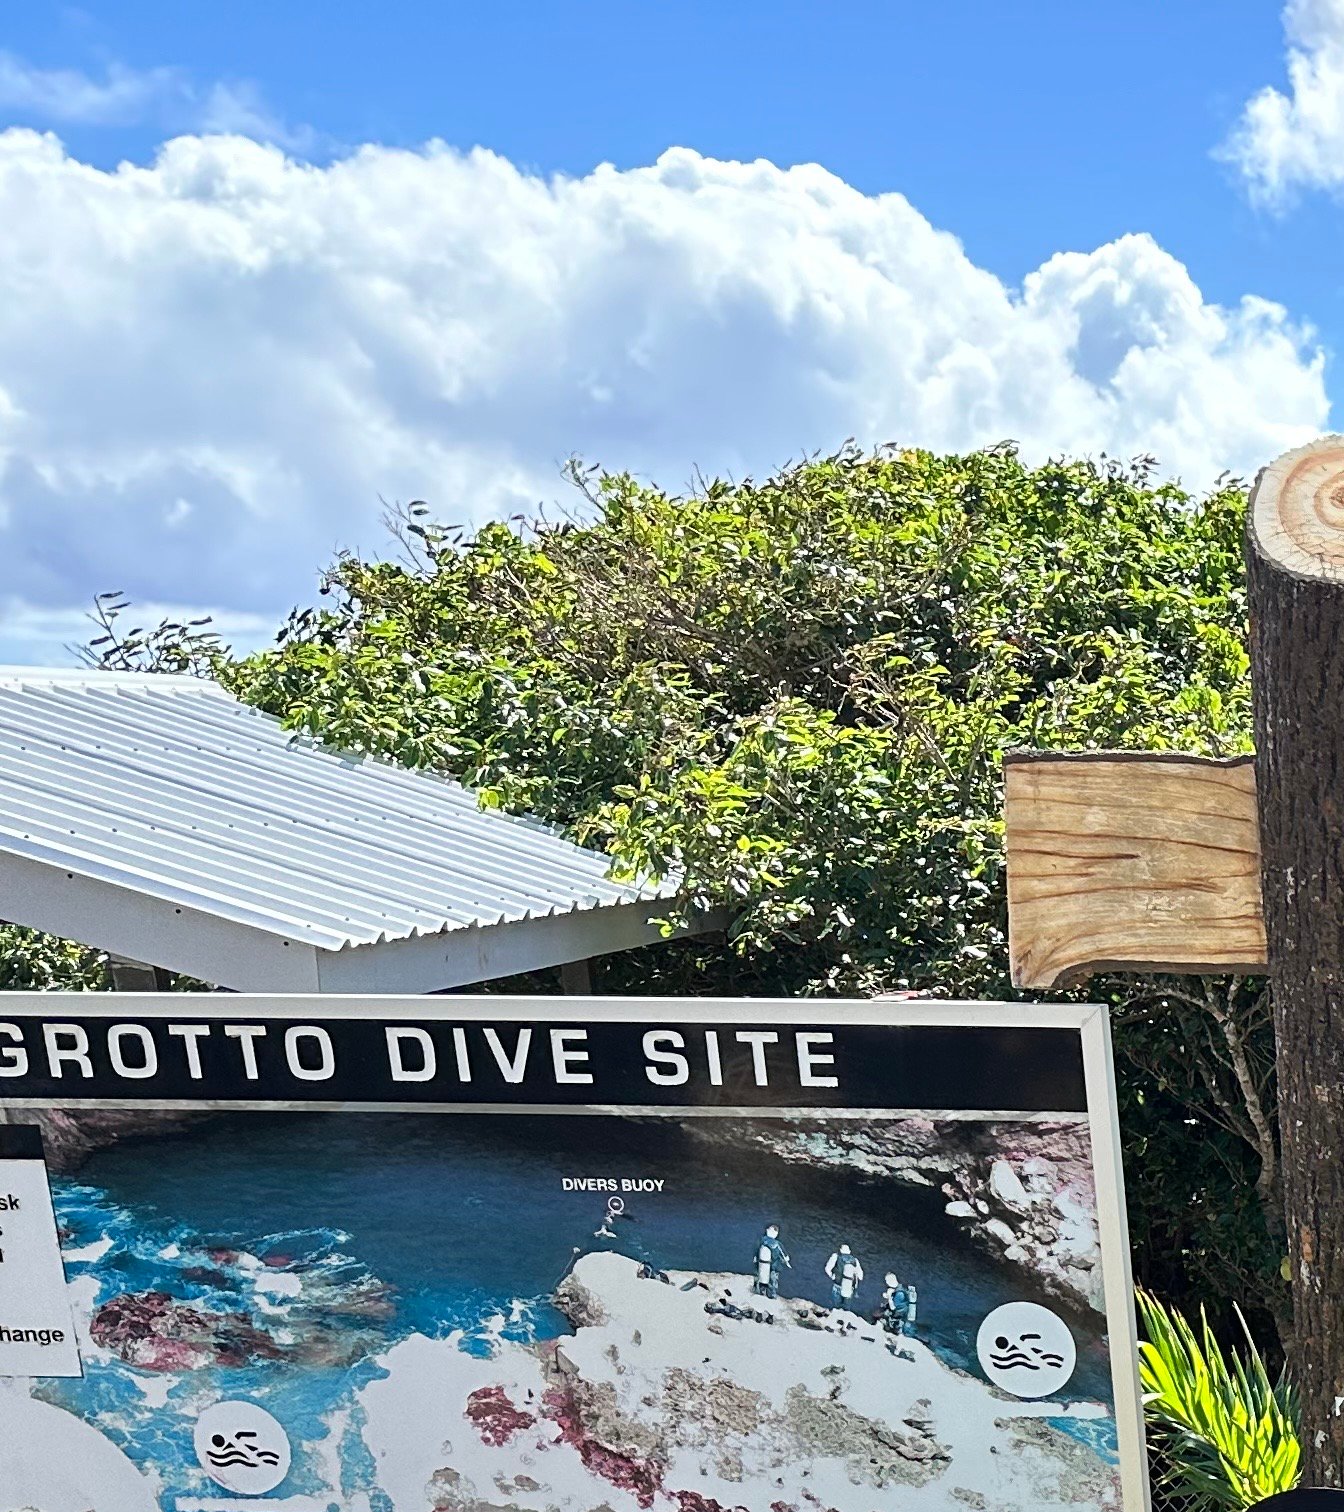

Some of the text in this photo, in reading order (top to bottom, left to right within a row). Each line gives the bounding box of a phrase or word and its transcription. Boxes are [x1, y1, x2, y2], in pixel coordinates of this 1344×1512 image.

[0, 1022, 839, 1088] GROTTO DIVE SITE
[562, 1178, 665, 1192] DIVERS BUOY
